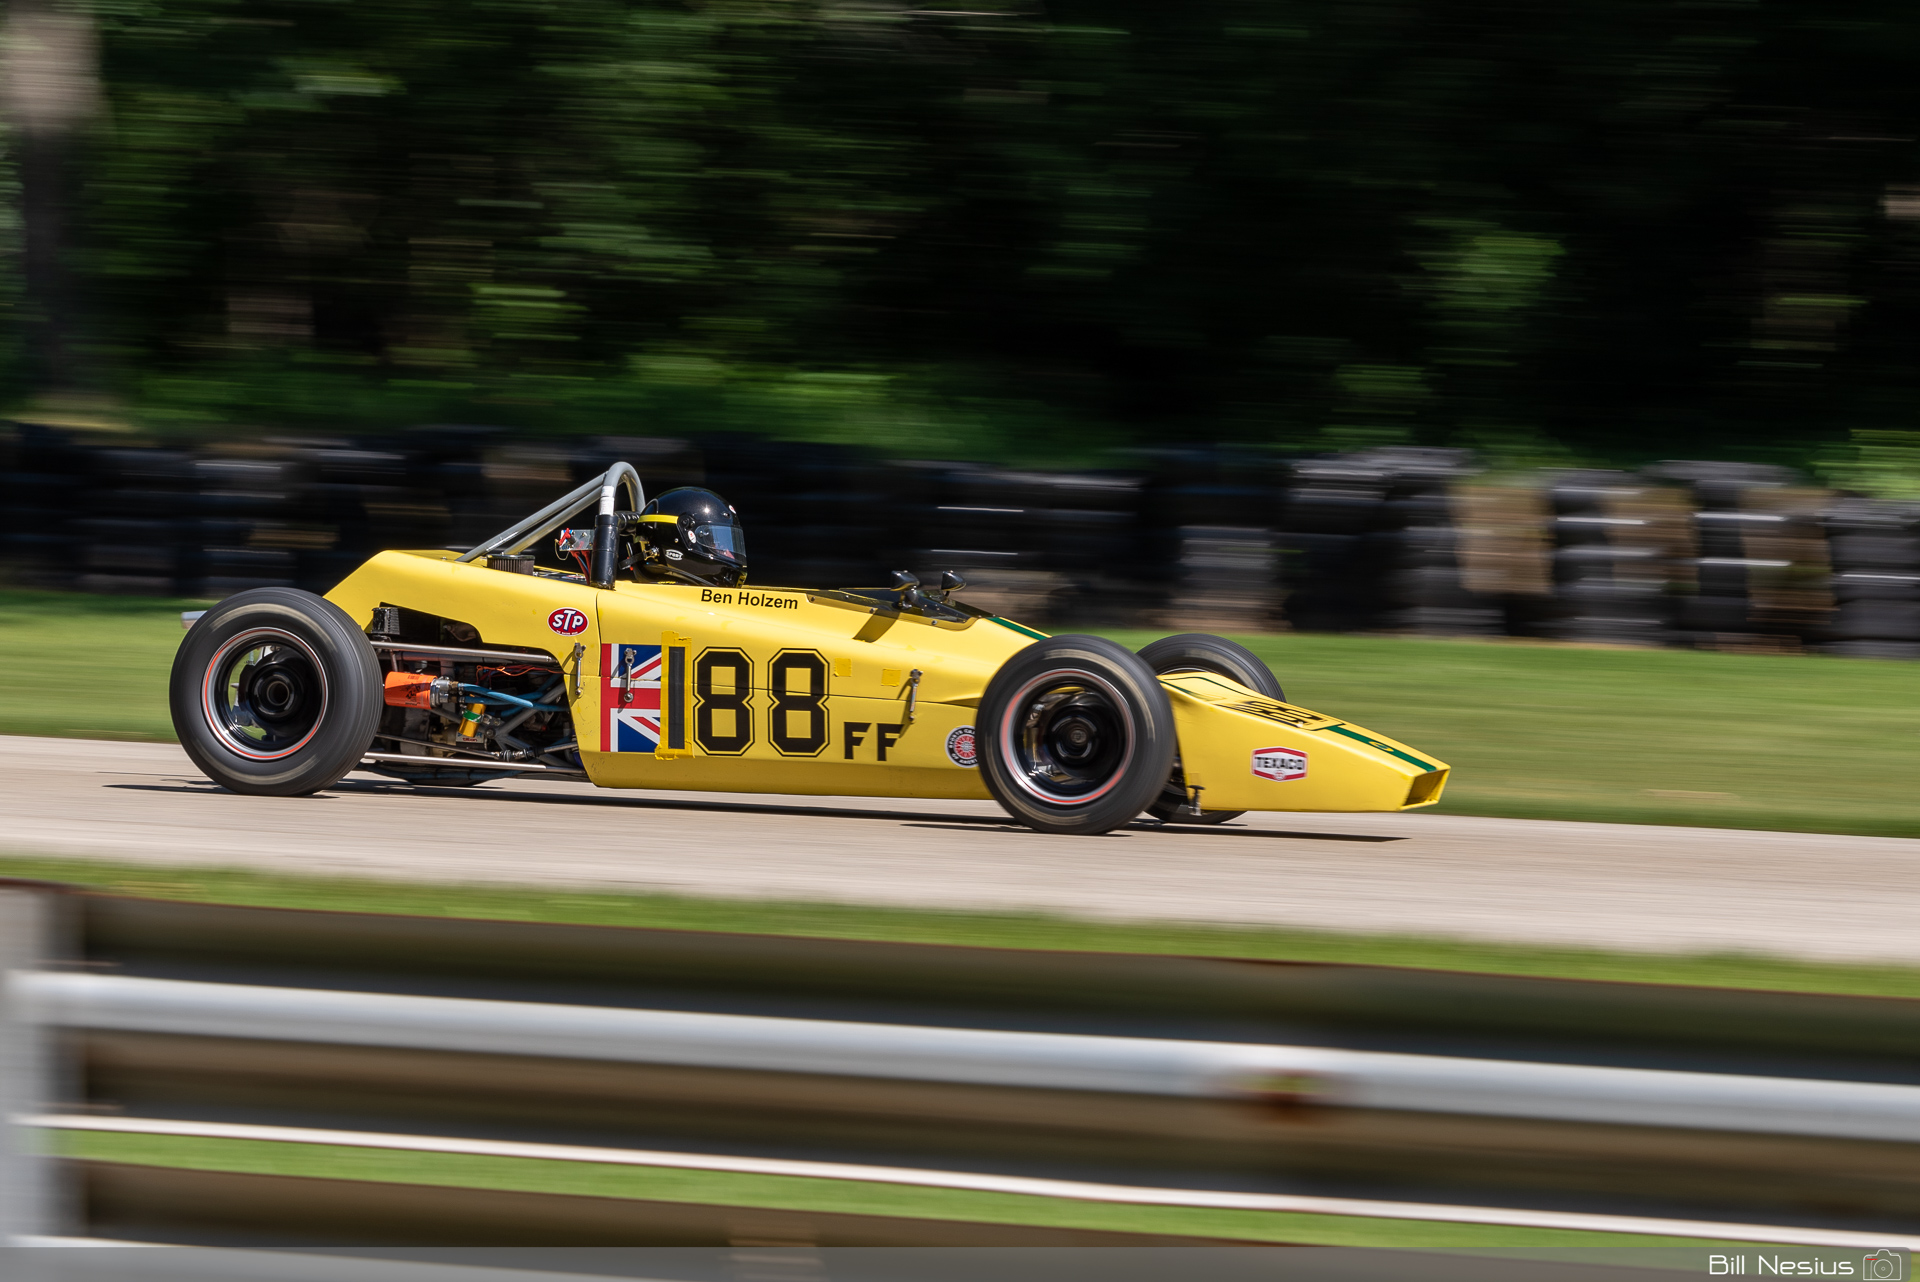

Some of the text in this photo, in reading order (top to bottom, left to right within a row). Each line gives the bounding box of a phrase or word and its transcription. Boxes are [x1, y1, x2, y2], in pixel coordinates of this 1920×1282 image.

[701, 589, 798, 610] Ben Holzem
[552, 609, 584, 631] STP
[668, 646, 905, 761] 188 FF
[1254, 757, 1305, 770] TEXACO
